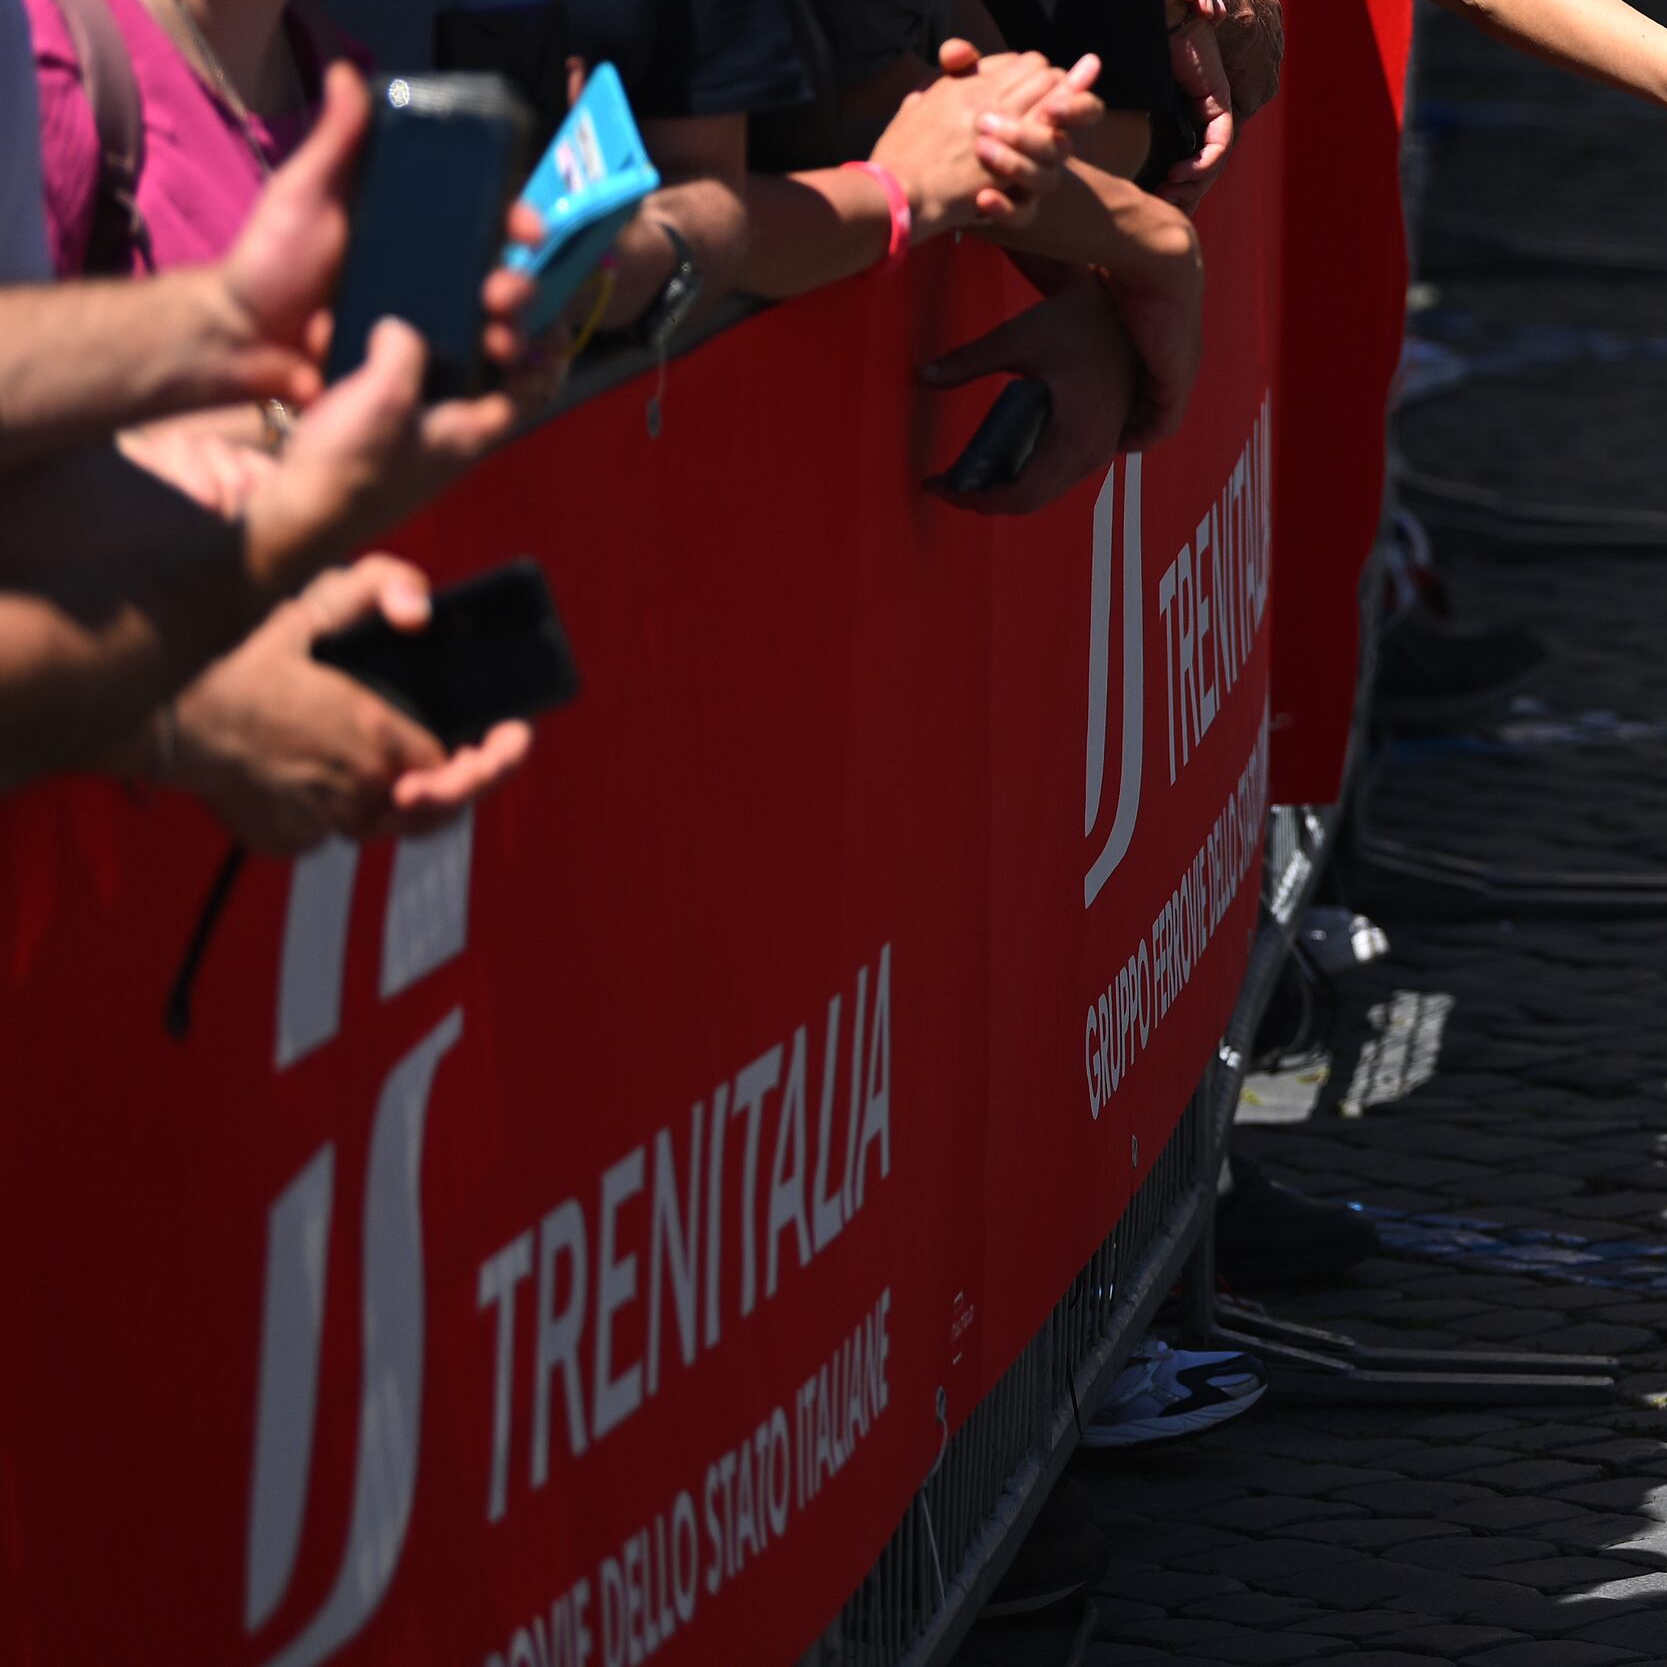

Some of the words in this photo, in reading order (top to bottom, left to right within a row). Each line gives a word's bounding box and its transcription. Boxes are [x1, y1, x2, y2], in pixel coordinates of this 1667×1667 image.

[1085, 937, 1151, 1120] GRUPPO
[1152, 845, 1208, 1030] FERROVIE
[1206, 792, 1238, 939] DELLO
[475, 939, 891, 1527] TRENITALIA
[599, 1489, 697, 1667] DELLO
[704, 1406, 792, 1597] STATO
[796, 1285, 891, 1512] ITALIANE
